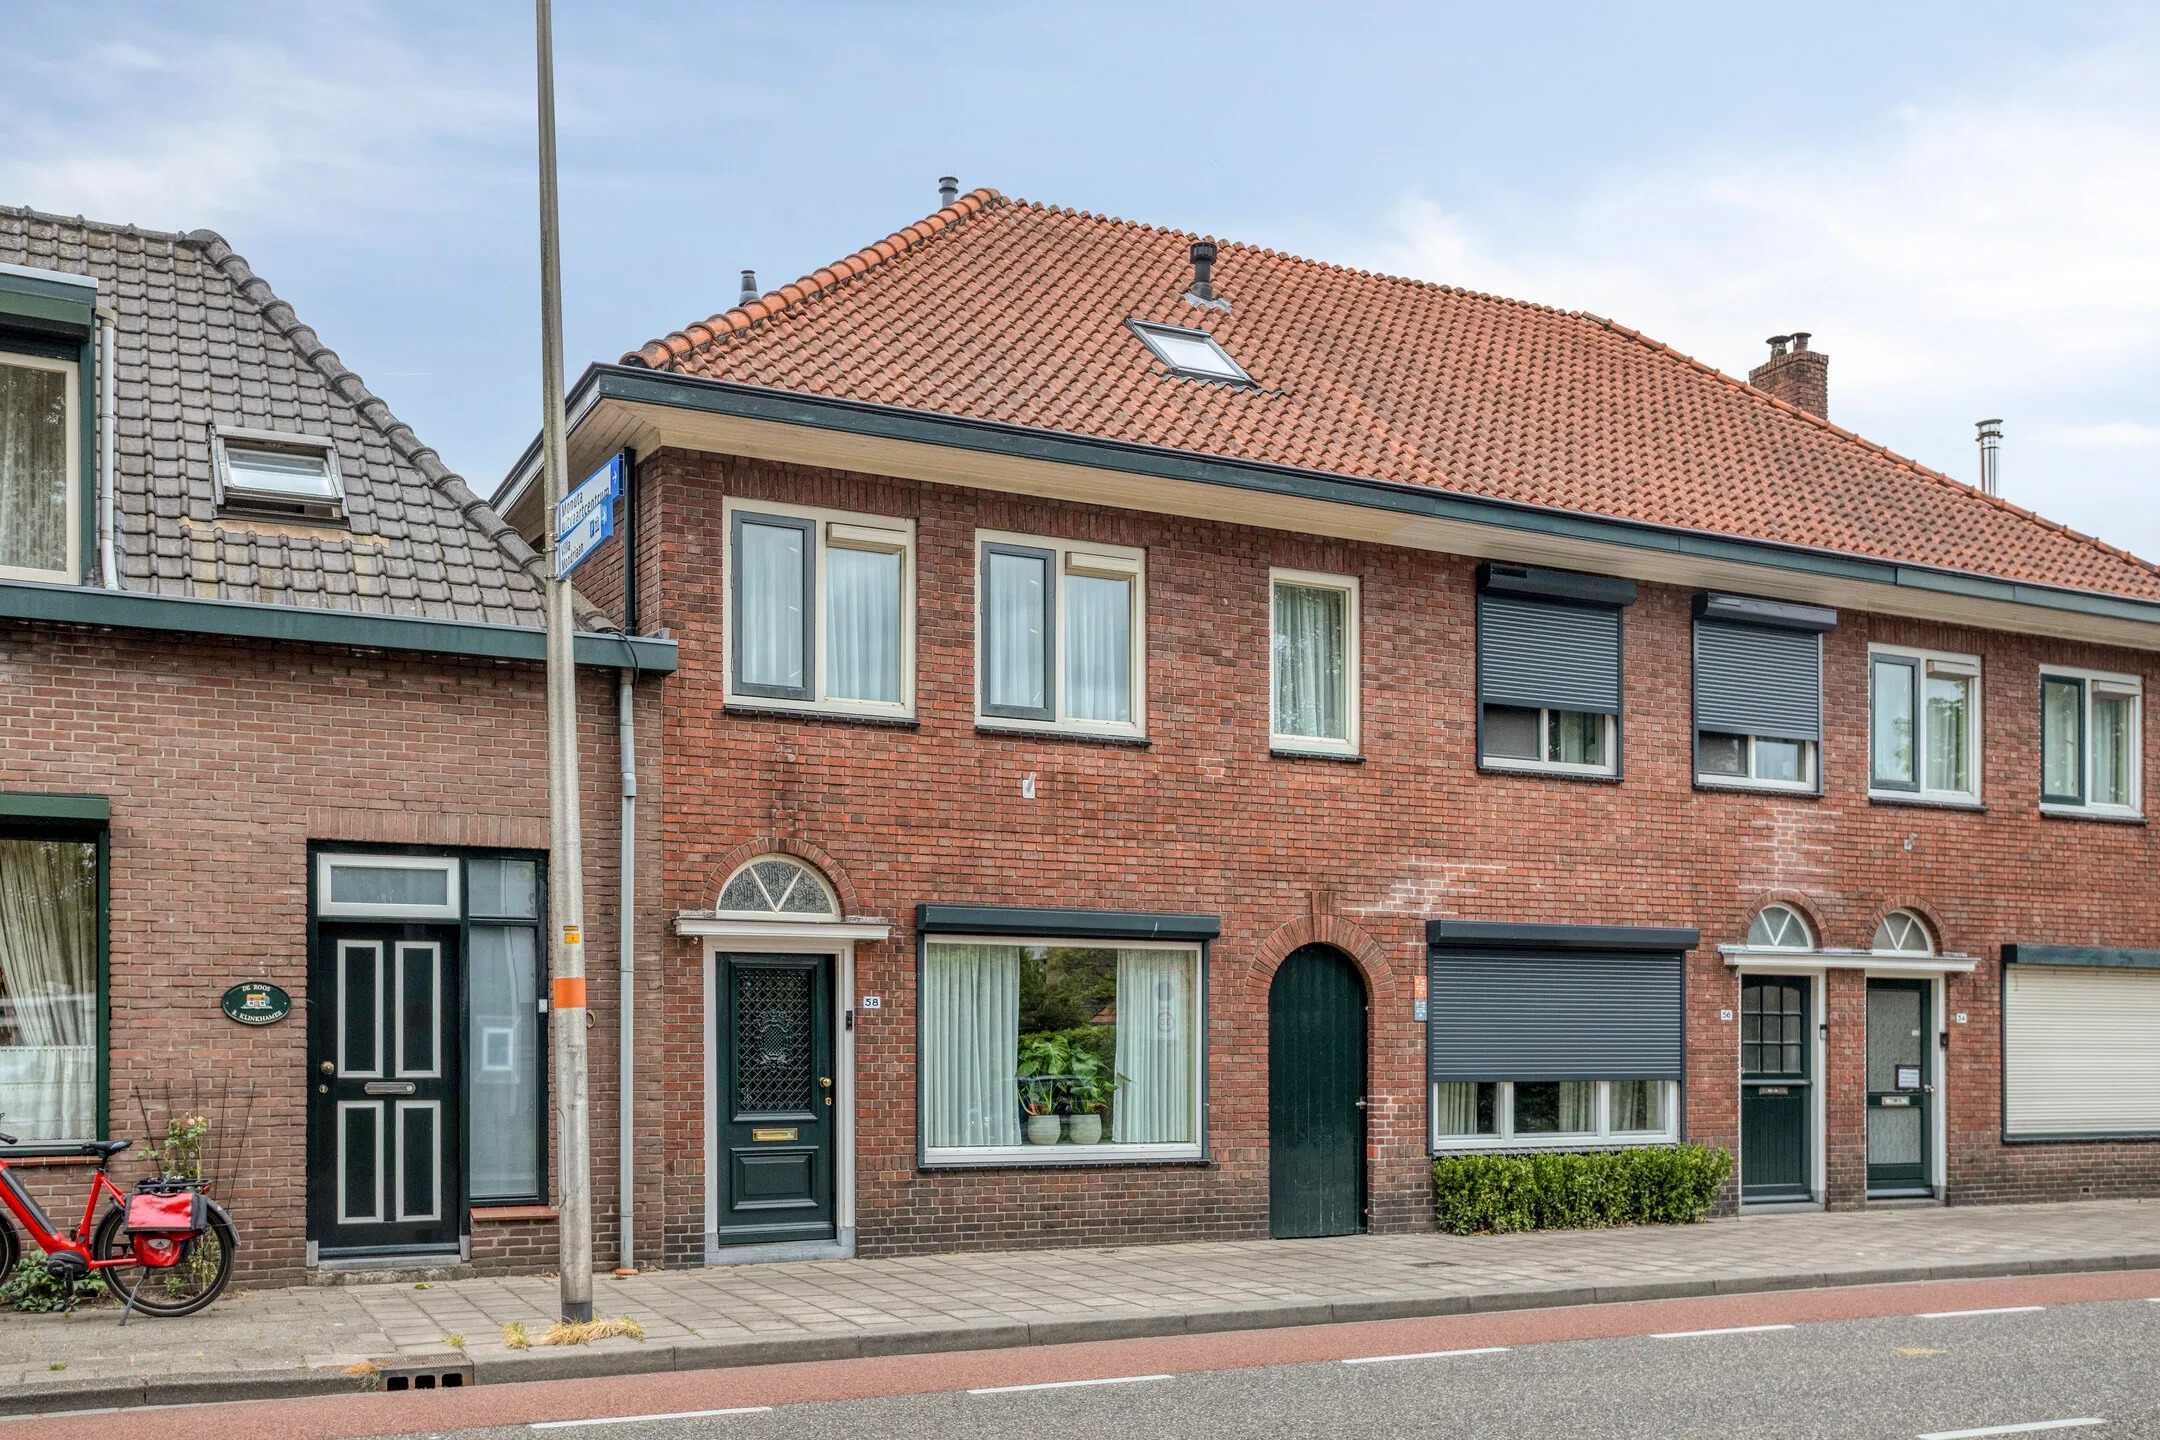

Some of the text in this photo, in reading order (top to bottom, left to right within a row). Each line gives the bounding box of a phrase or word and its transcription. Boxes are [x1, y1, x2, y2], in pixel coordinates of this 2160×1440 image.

[562, 492, 583, 517] Monuta
[253, 984, 271, 992] ROOS
[865, 998, 879, 1007] 58
[239, 1010, 283, 1022] KLINKHAMER
